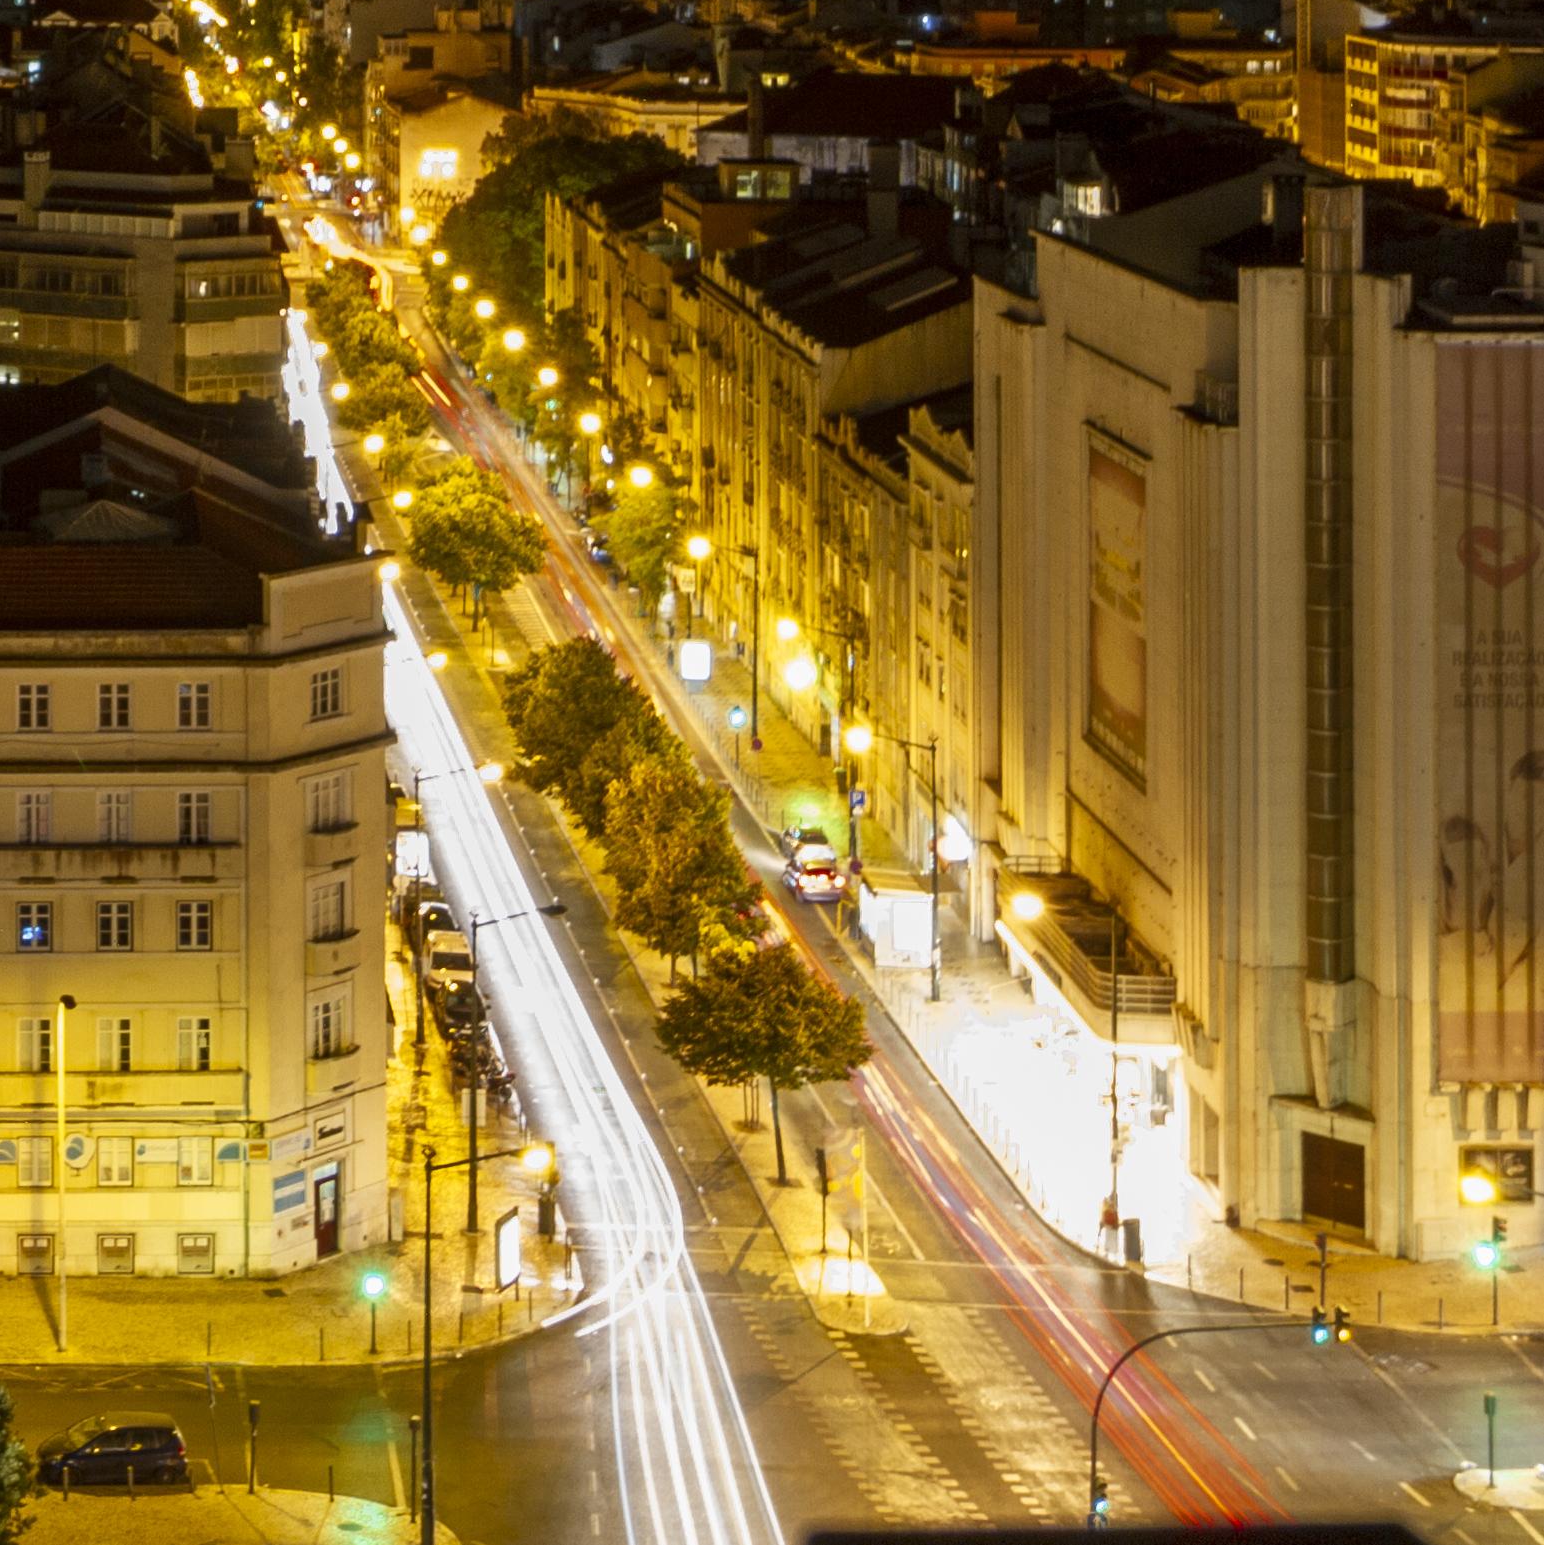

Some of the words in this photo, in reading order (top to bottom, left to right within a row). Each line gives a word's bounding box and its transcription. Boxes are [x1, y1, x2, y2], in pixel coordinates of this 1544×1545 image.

[1476, 629, 1486, 645] A
[1492, 629, 1522, 645] SUA
[1473, 671, 1483, 687] A
[1488, 671, 1540, 688] NOSSA
